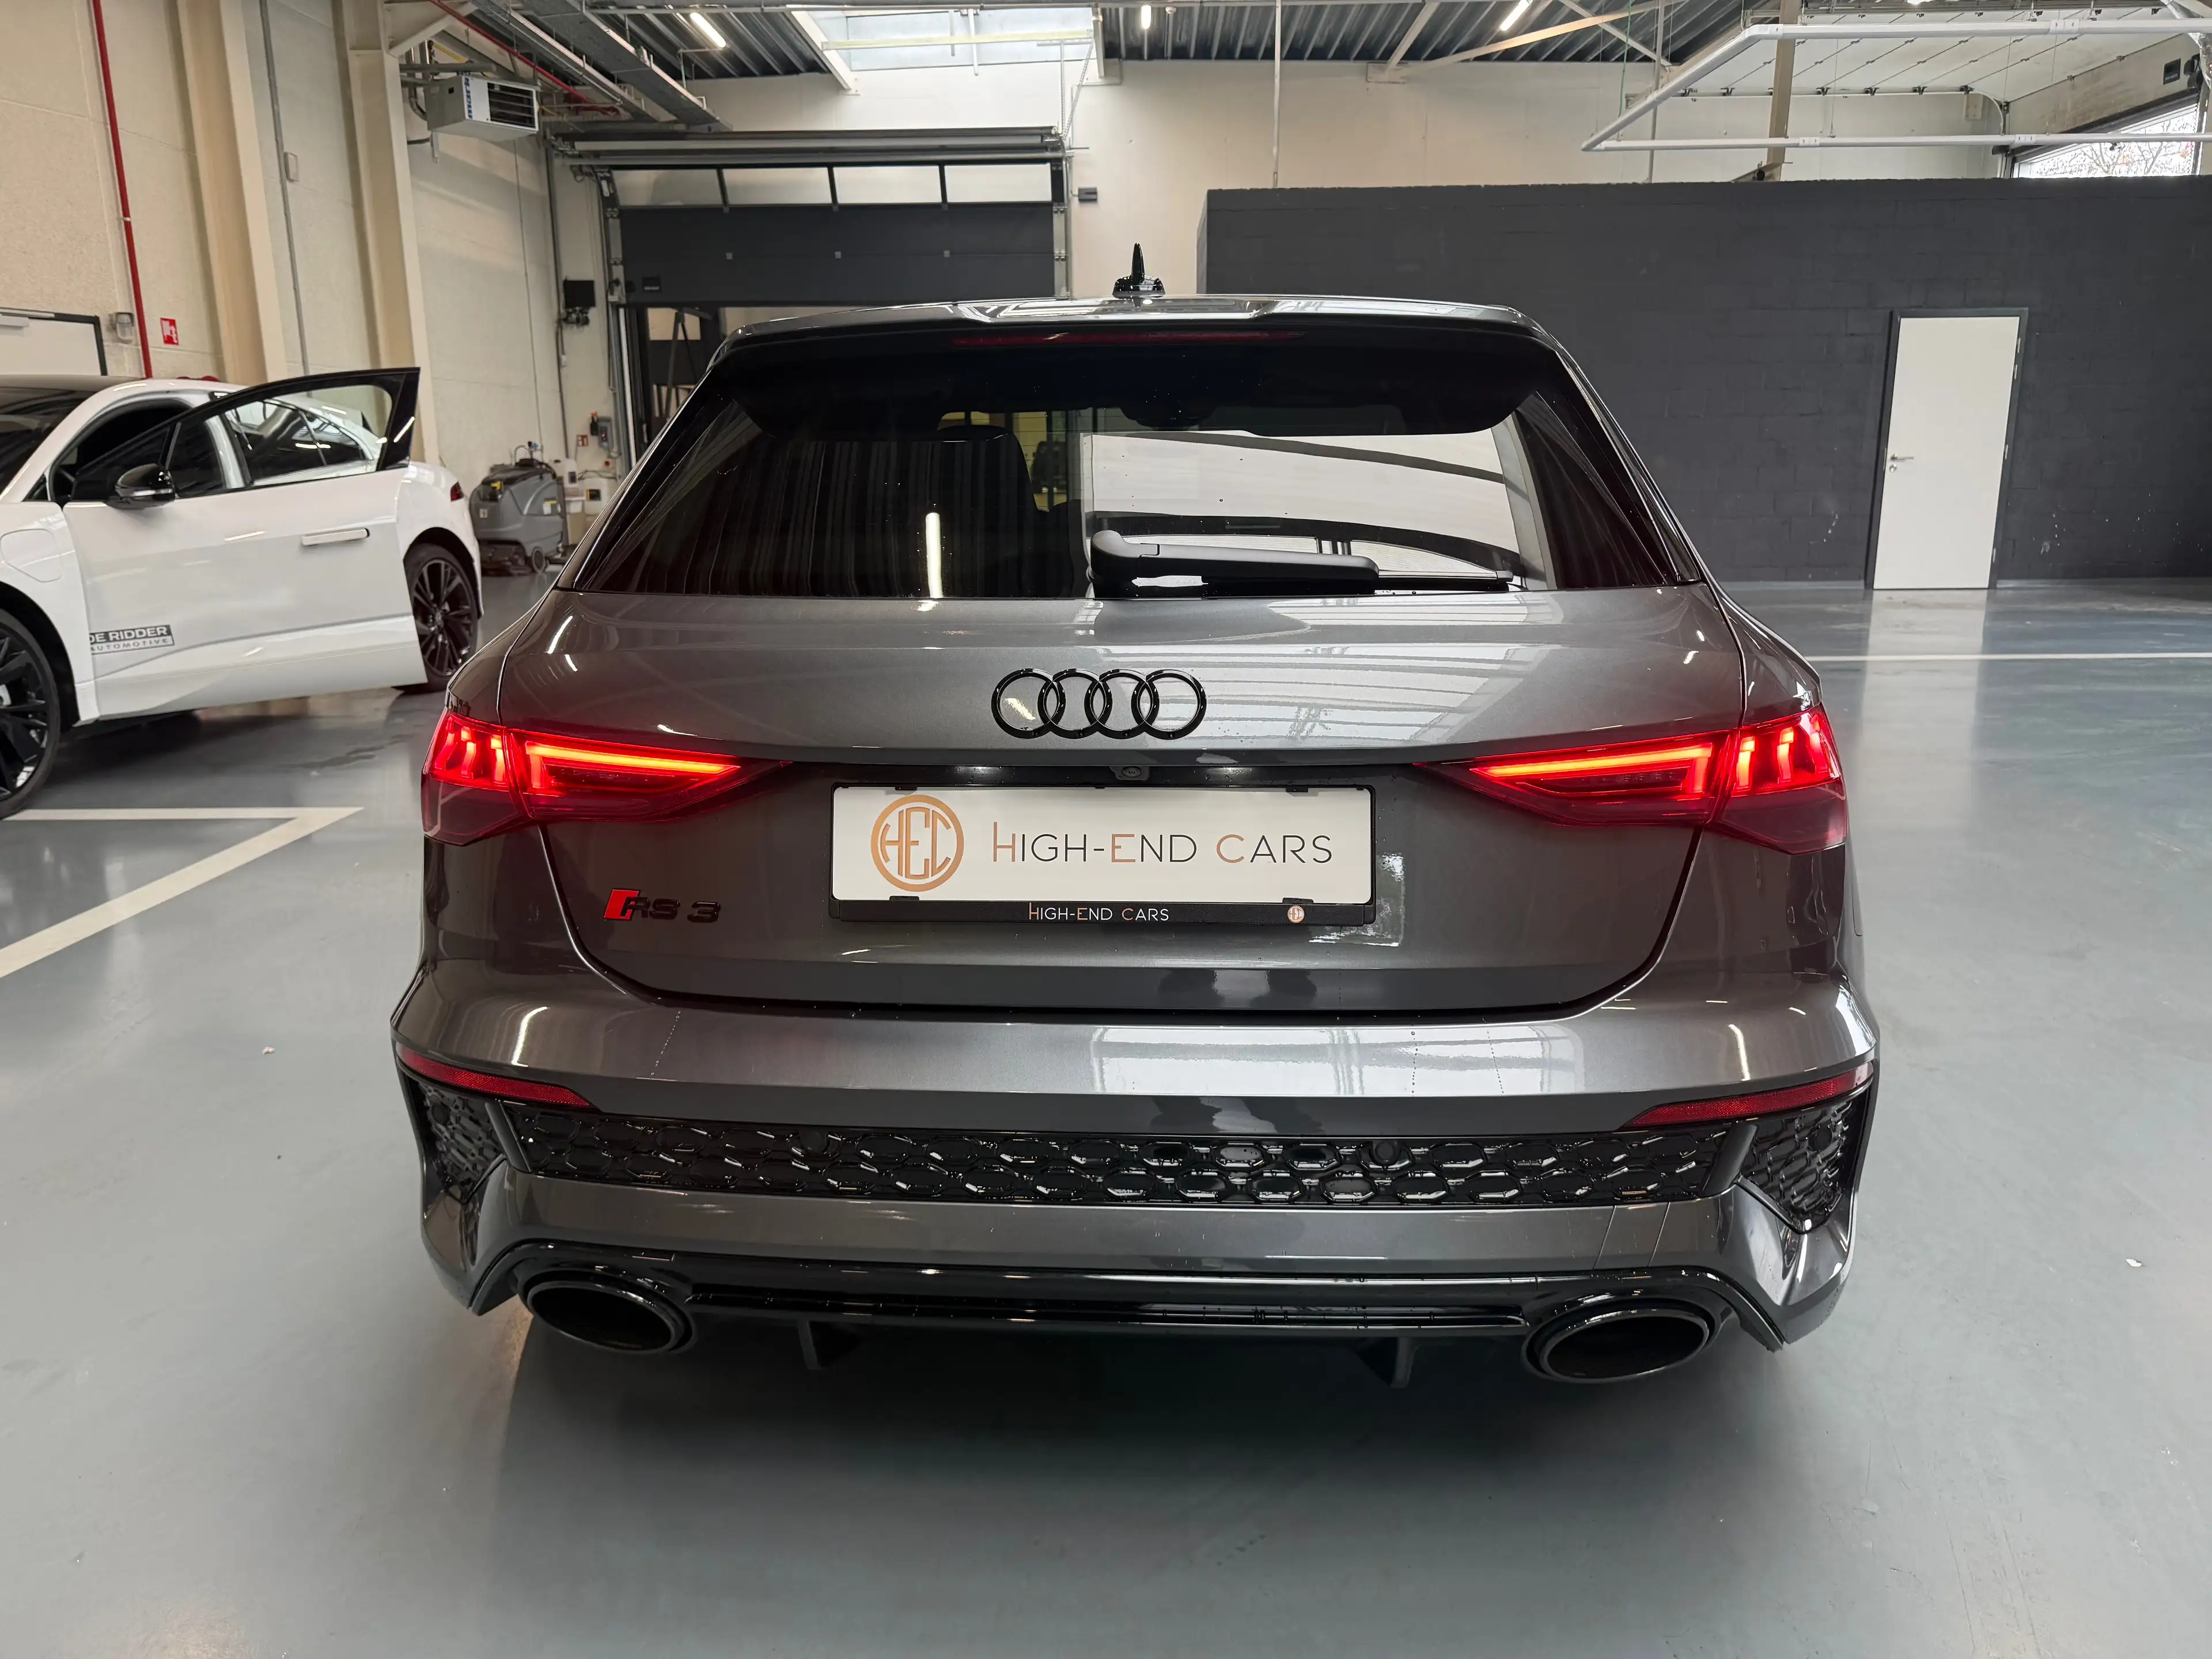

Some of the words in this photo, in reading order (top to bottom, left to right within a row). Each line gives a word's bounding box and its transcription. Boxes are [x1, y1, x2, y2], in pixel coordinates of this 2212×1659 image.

[89, 632, 107, 644] DE
[108, 626, 168, 641] RIDDER
[90, 638, 169, 652] AUTOMOTIVE
[993, 821, 1197, 863] HIGH-END
[1216, 834, 1332, 863] CARS
[612, 893, 681, 921] RS
[687, 901, 721, 923] 3
[1028, 902, 1113, 921] HIGH-END
[1122, 907, 1170, 922] CARS
